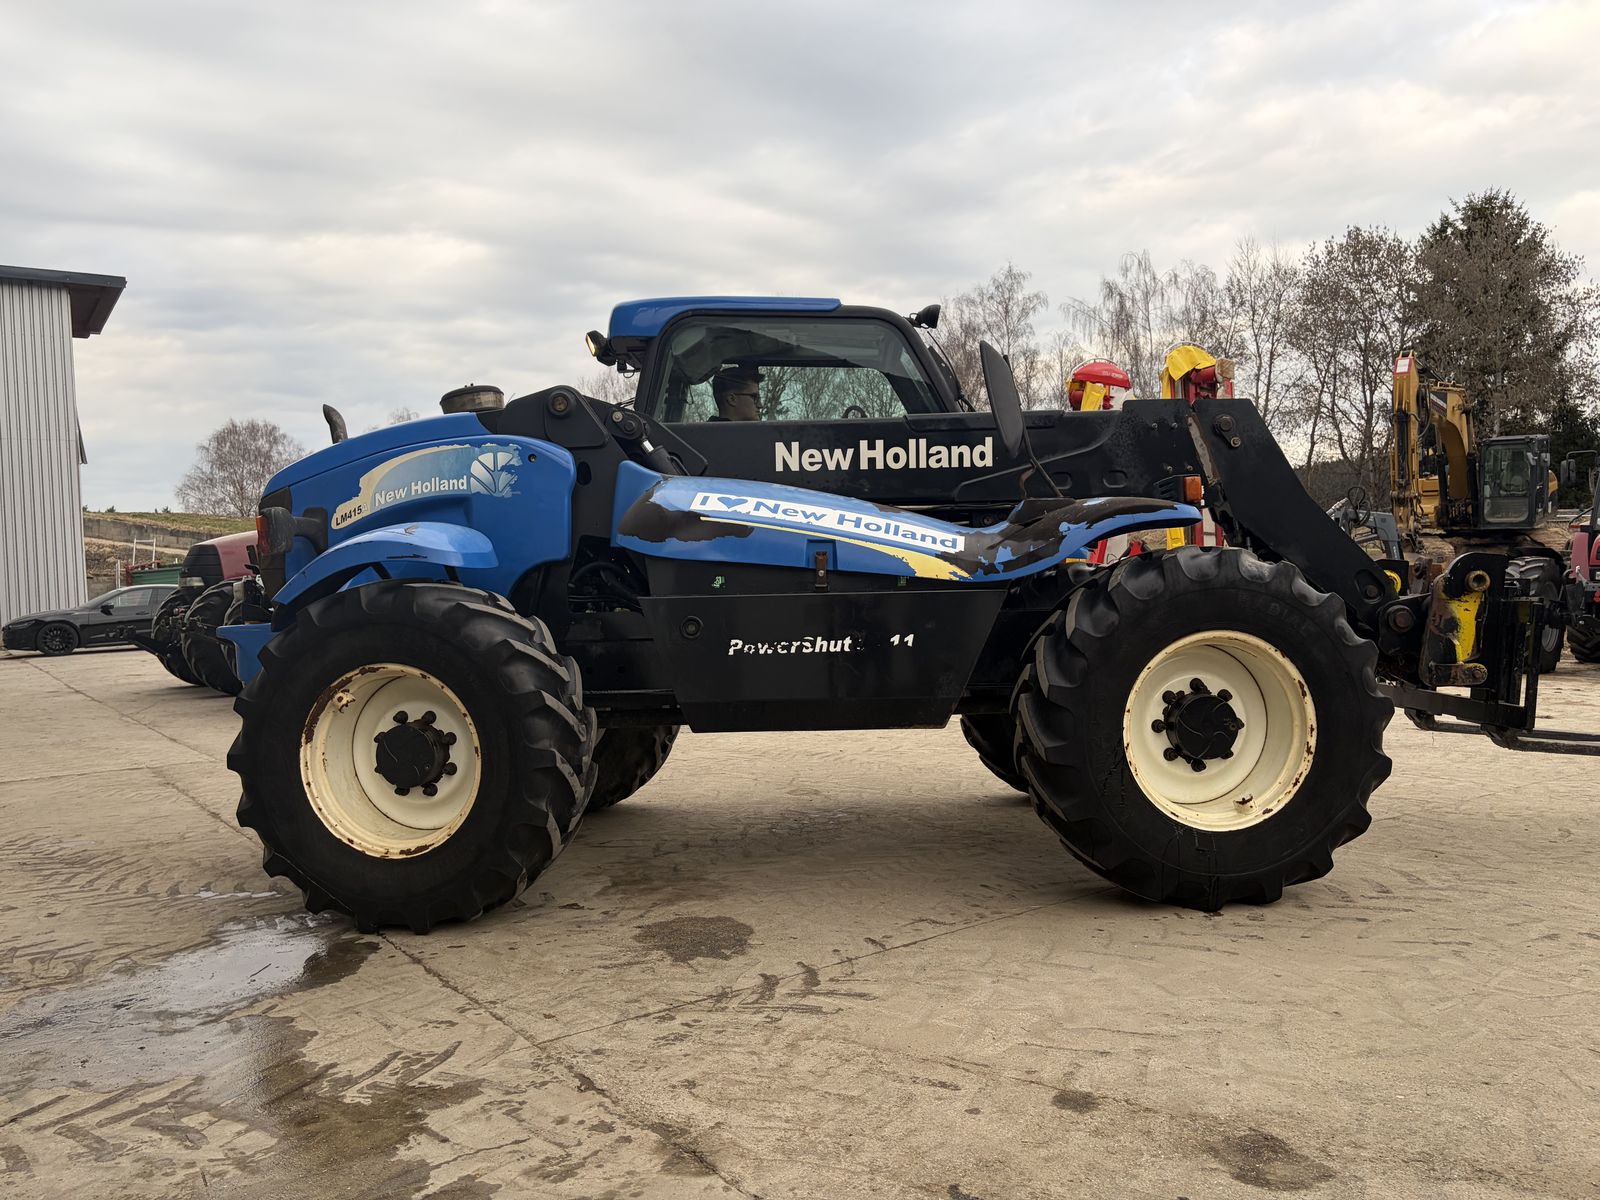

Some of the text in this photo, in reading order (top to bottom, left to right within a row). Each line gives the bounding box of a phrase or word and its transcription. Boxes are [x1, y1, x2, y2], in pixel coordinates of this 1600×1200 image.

[775, 437, 993, 472] New Holland
[375, 475, 467, 507] New Holland
[699, 495, 958, 550] I New Holland
